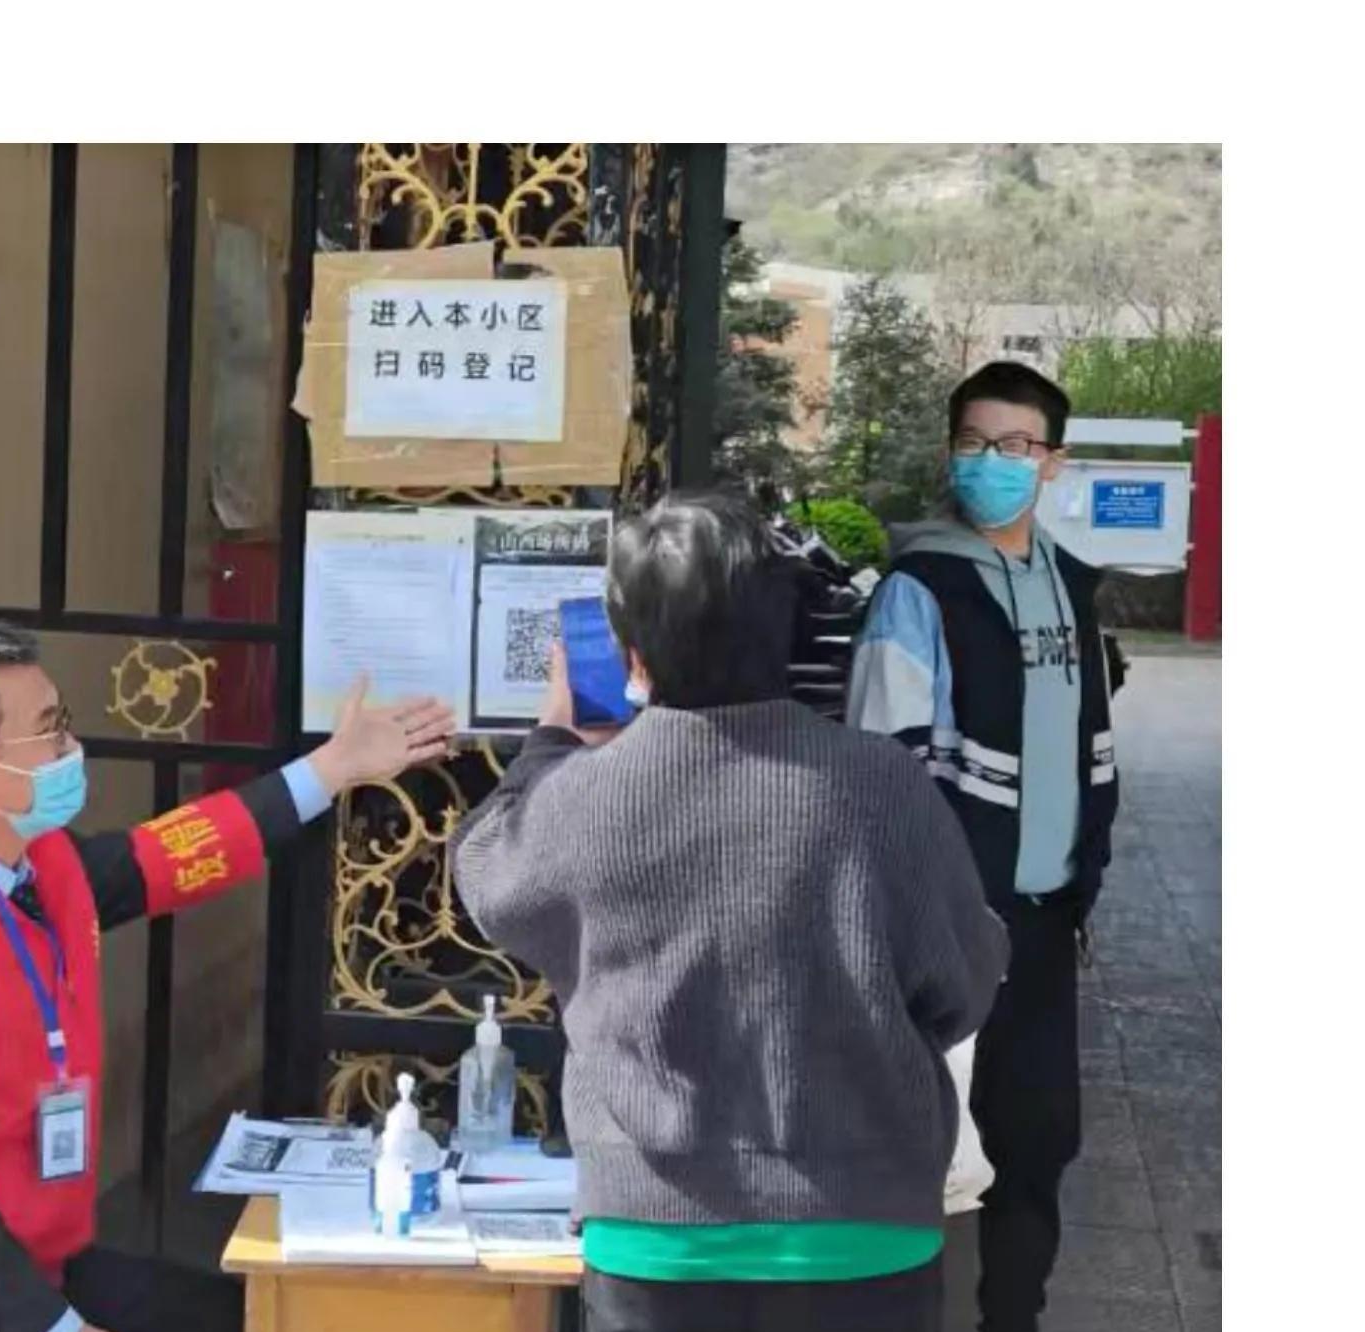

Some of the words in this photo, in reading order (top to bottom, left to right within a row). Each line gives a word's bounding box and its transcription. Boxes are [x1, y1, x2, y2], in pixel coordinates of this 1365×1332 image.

[369, 299, 545, 333] 进入本小区
[374, 350, 537, 383] 扫码登记
